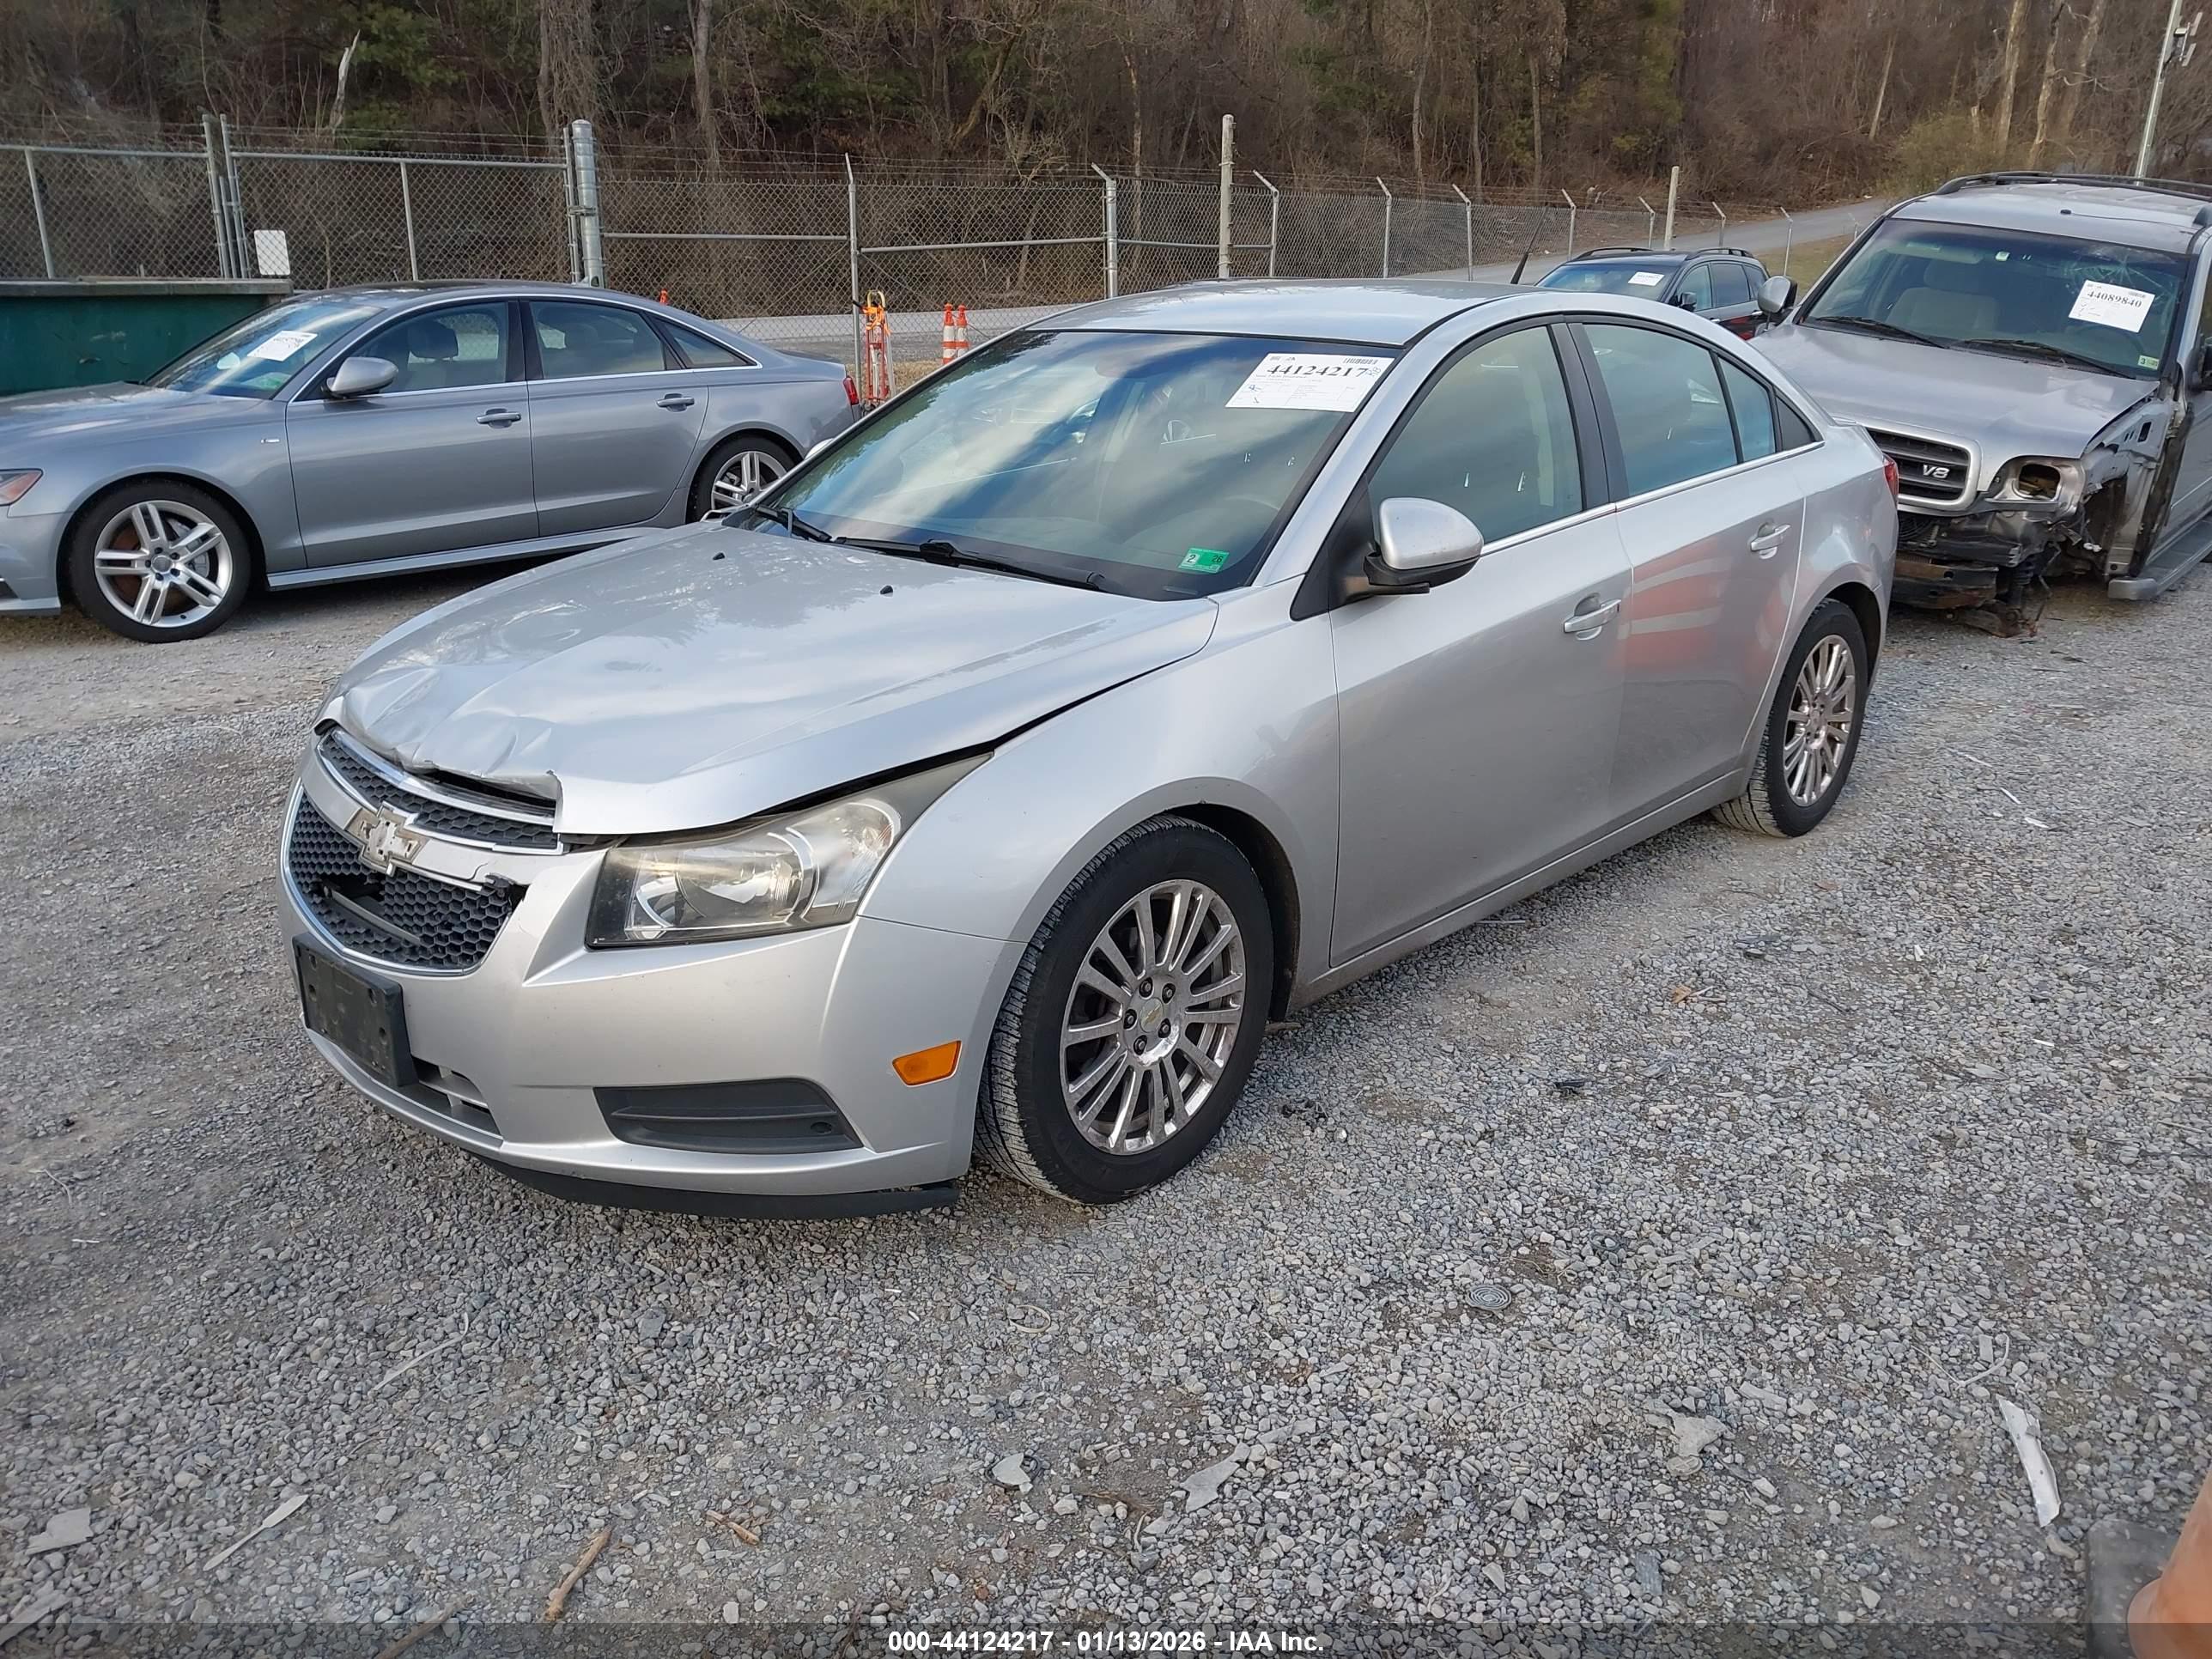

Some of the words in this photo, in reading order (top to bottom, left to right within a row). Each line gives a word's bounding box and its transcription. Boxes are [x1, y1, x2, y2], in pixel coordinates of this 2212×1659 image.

[2087, 290, 2142, 308] 44089840
[1267, 364, 1370, 378] 44124217
[1923, 464, 1950, 479] V8
[1187, 554, 1196, 563] 2
[1212, 555, 1224, 563] 26
